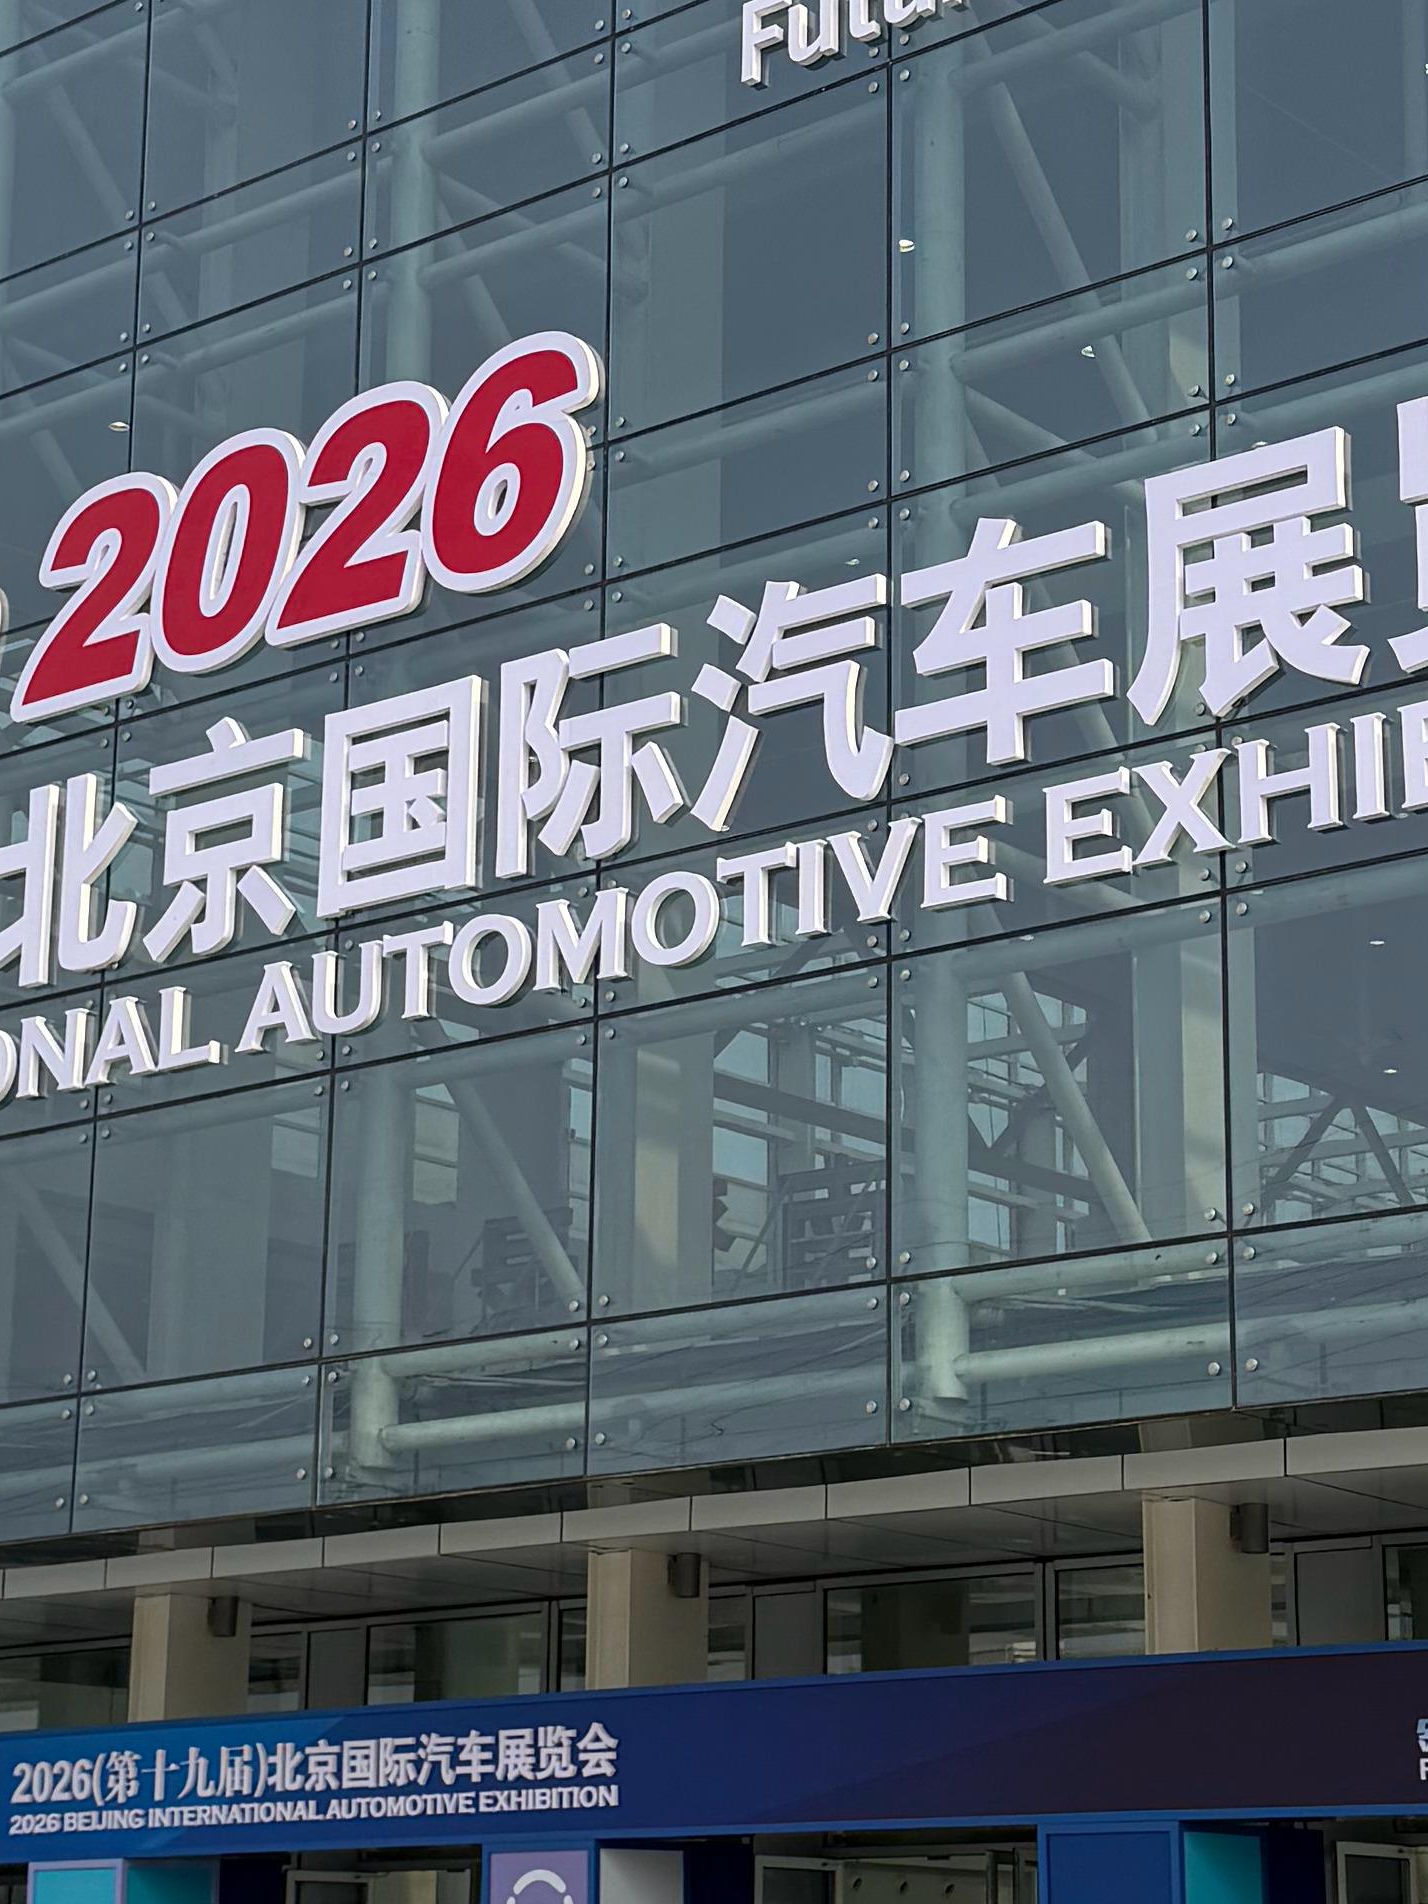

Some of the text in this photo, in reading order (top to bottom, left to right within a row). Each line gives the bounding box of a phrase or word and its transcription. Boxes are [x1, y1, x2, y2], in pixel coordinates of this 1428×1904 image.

[10, 330, 603, 723] 2026
[235, 794, 1013, 1055] AUTOMOTIVE
[9, 1785, 619, 1835] 2026 BEIJING INTERNATIONAL AUTOMOTIVE EXHIBITION
